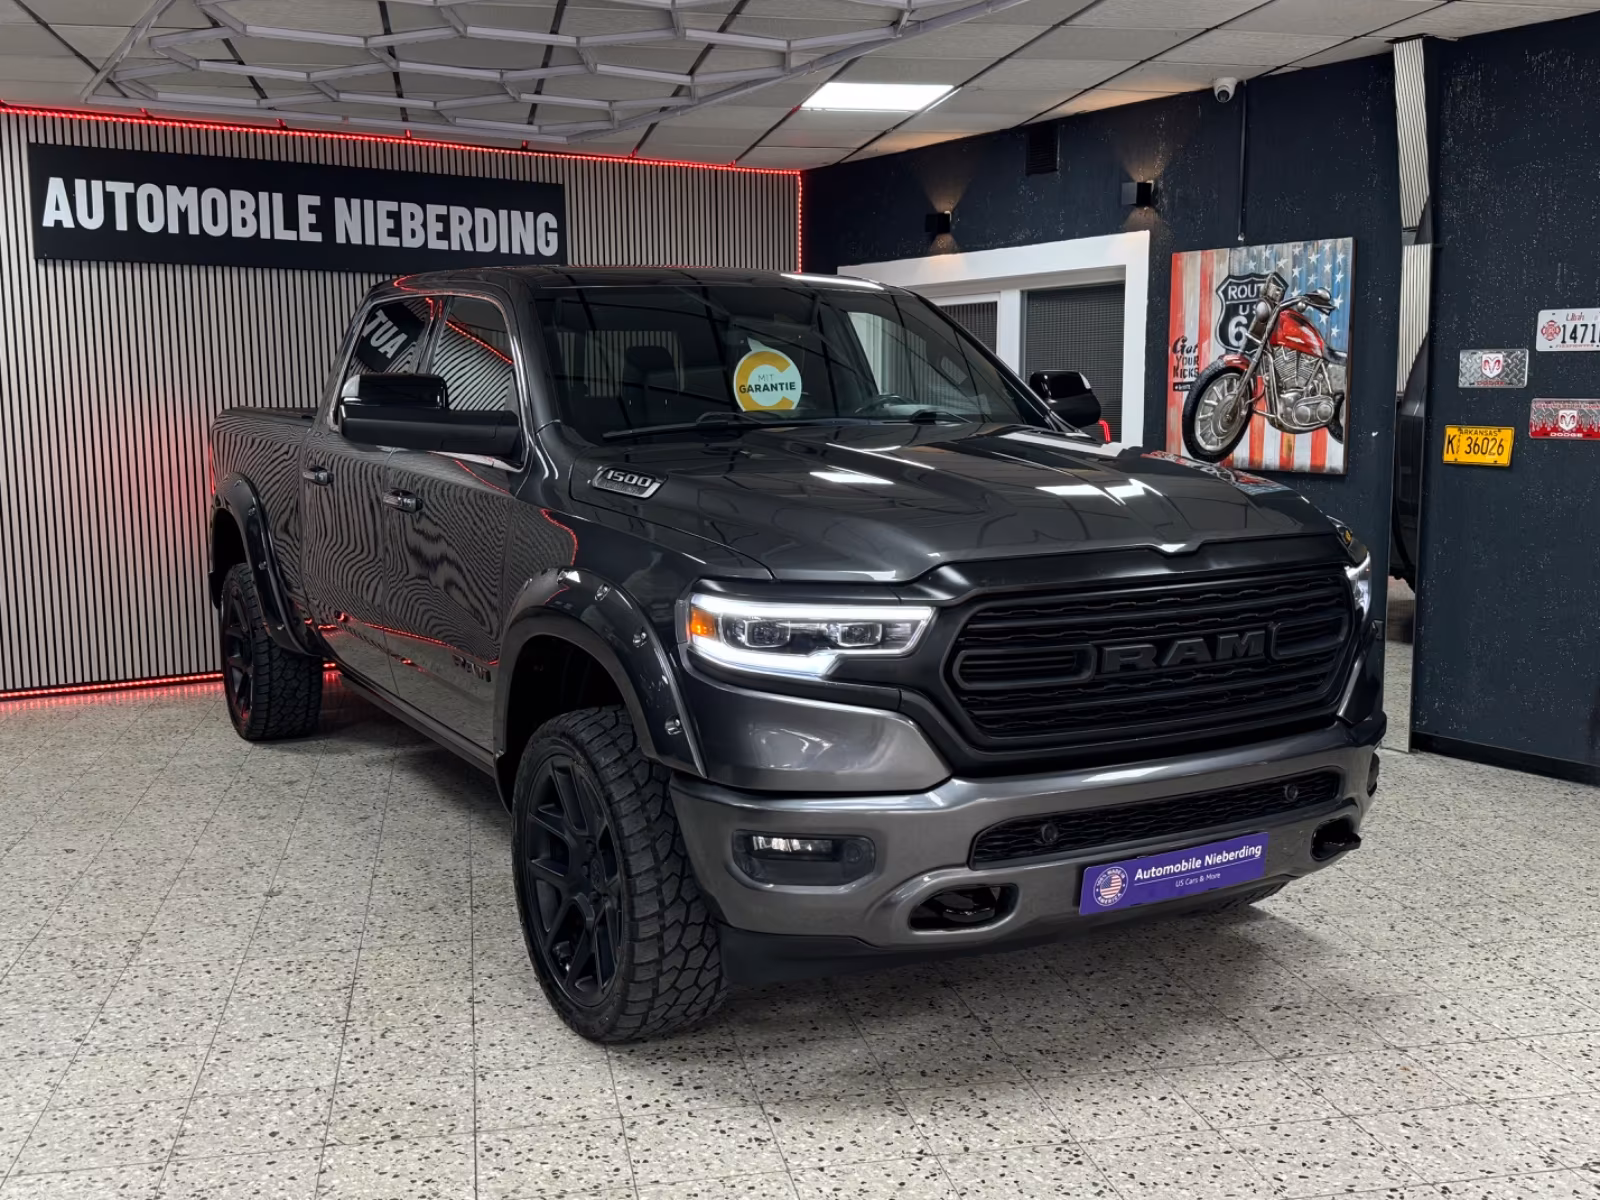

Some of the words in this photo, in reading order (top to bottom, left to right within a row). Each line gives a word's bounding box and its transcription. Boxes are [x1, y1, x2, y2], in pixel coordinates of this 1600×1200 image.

[42, 177, 322, 242] AUTOMOBILE
[334, 197, 558, 257] NIEBERDING
[1561, 323, 1600, 344] 1471
[758, 374, 775, 382] MIT
[739, 381, 796, 394] GARANTIE
[1459, 429, 1498, 437] ARKANSAS
[1464, 436, 1505, 456] 36026
[607, 470, 652, 487] 1500
[1101, 630, 1266, 673] RAM
[1134, 857, 1202, 881] Automobile
[1204, 845, 1262, 867] Nieberding
[1175, 879, 1185, 888] US
[1185, 876, 1199, 886] Cars
[1199, 875, 1206, 883] &
[1206, 872, 1221, 881] More
